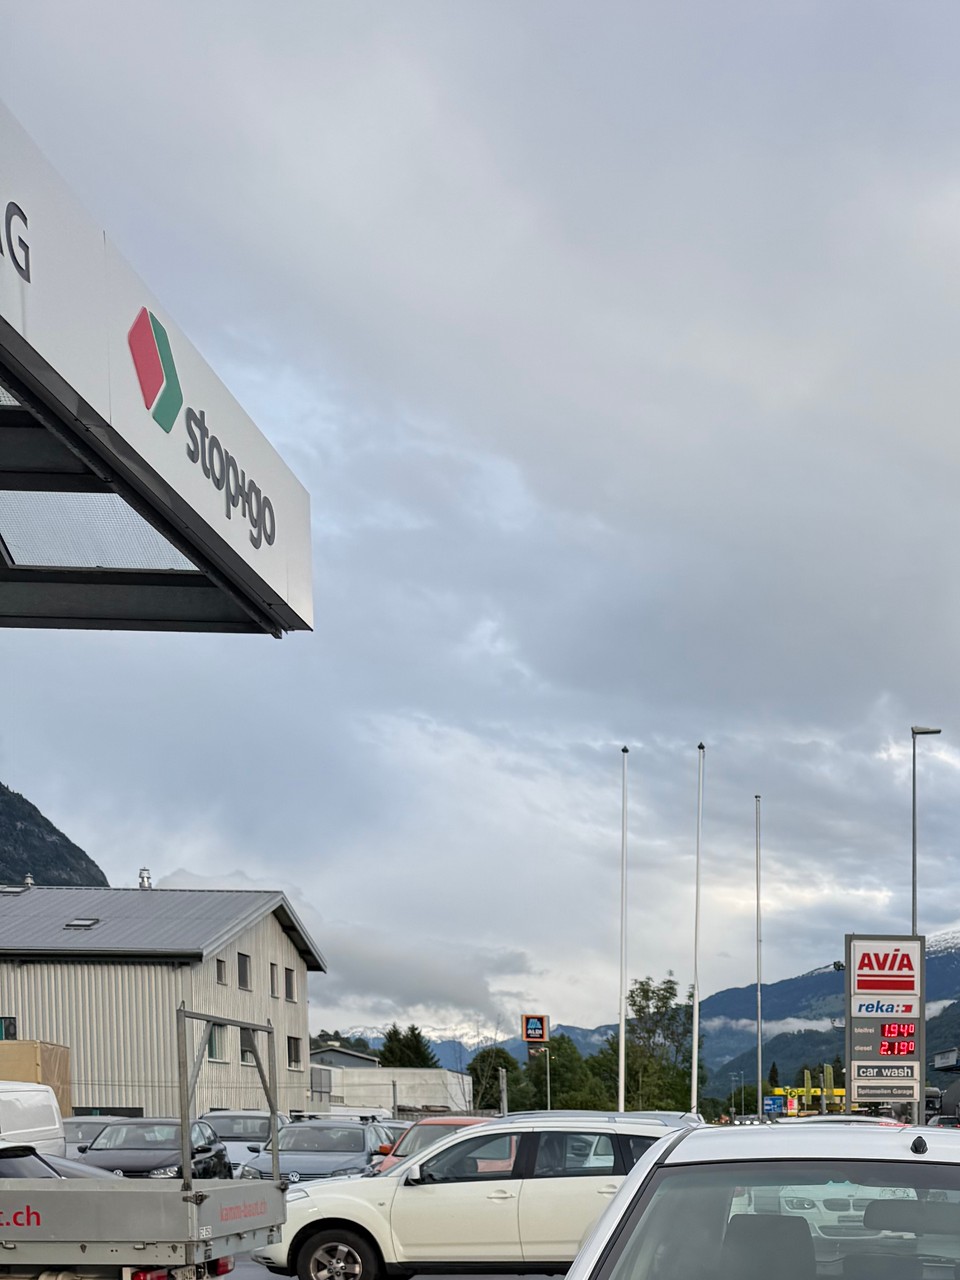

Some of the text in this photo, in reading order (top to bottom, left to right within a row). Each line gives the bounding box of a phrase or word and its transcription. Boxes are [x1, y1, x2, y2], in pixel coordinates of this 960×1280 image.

[0, 201, 32, 284] G
[185, 406, 276, 550] stop+go
[859, 1066, 912, 1077] car wash
